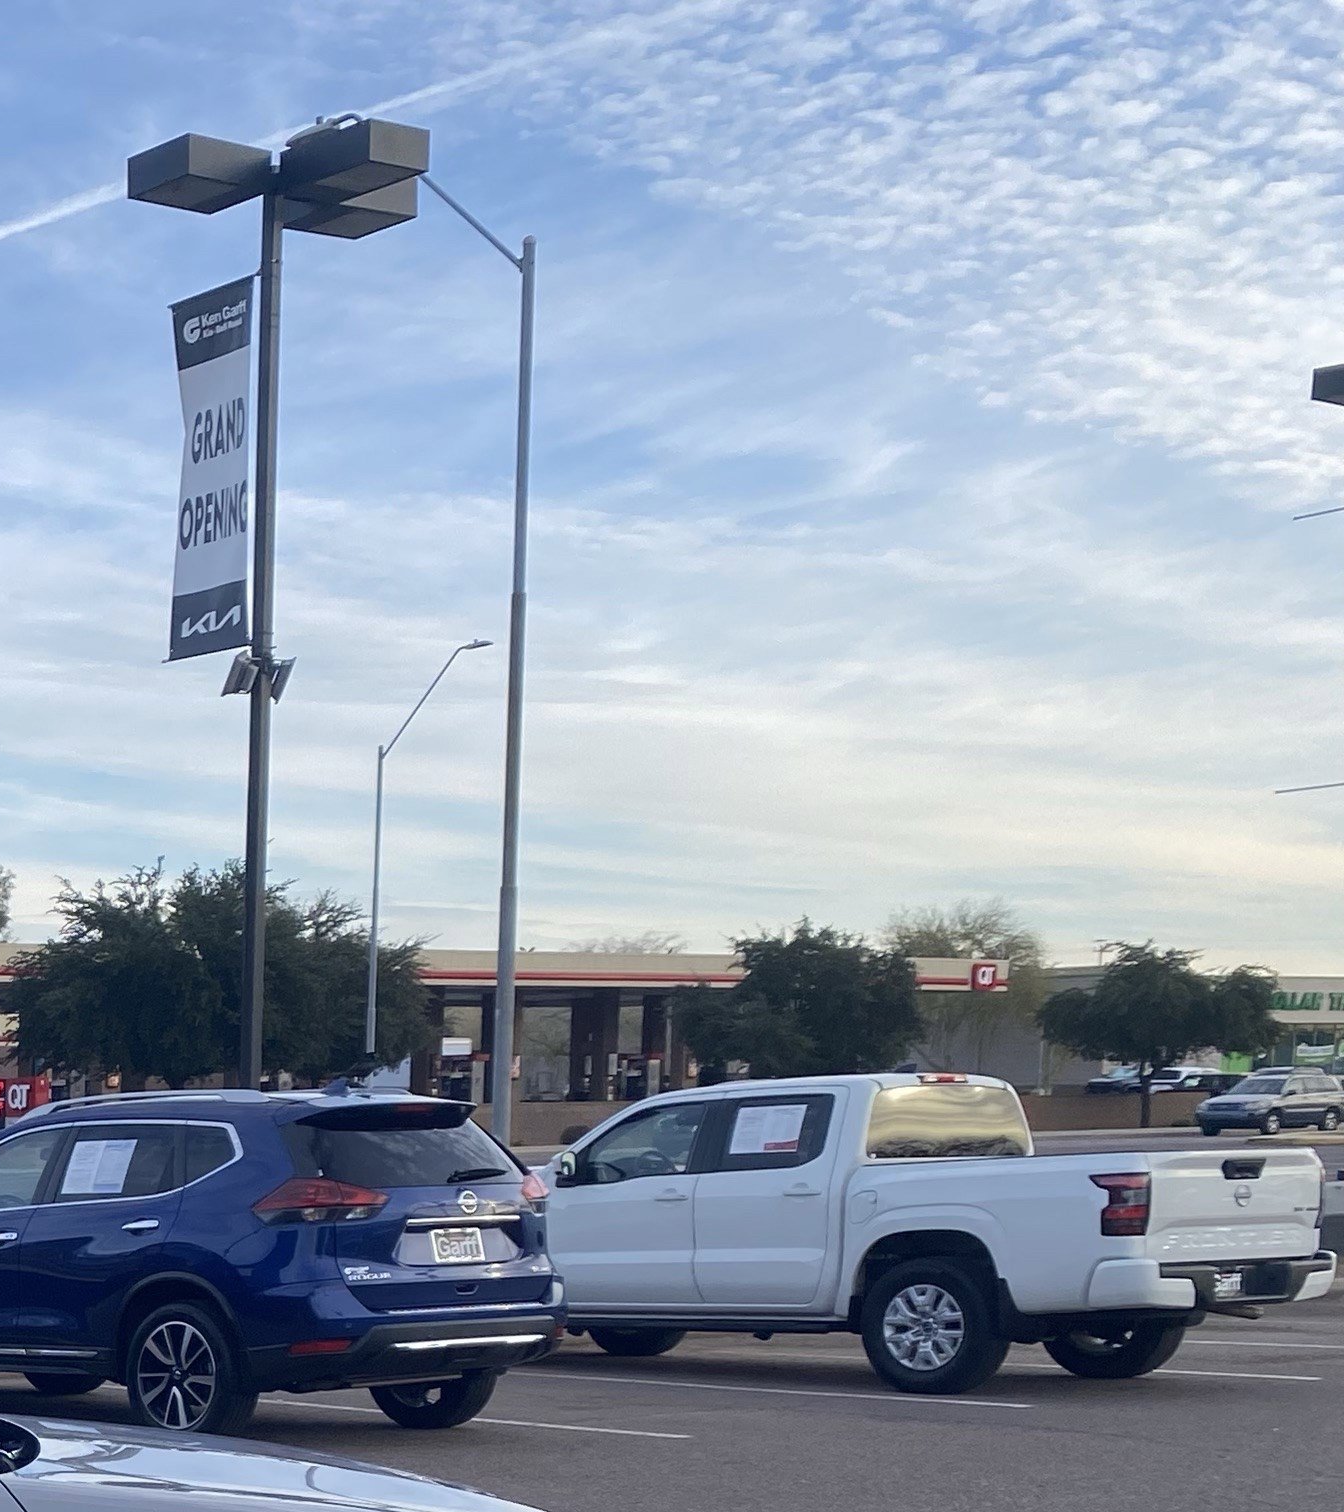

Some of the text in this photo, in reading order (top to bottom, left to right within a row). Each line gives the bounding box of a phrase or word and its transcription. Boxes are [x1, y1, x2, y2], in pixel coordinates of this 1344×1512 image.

[201, 299, 247, 327] Ken Garff
[191, 397, 245, 464] GRAND
[179, 479, 248, 550] OPENING
[180, 604, 242, 638] KIA
[976, 966, 996, 985] QT
[1269, 991, 1323, 1011] OLLAR
[8, 1084, 31, 1110] QT
[437, 1234, 479, 1256] Garff
